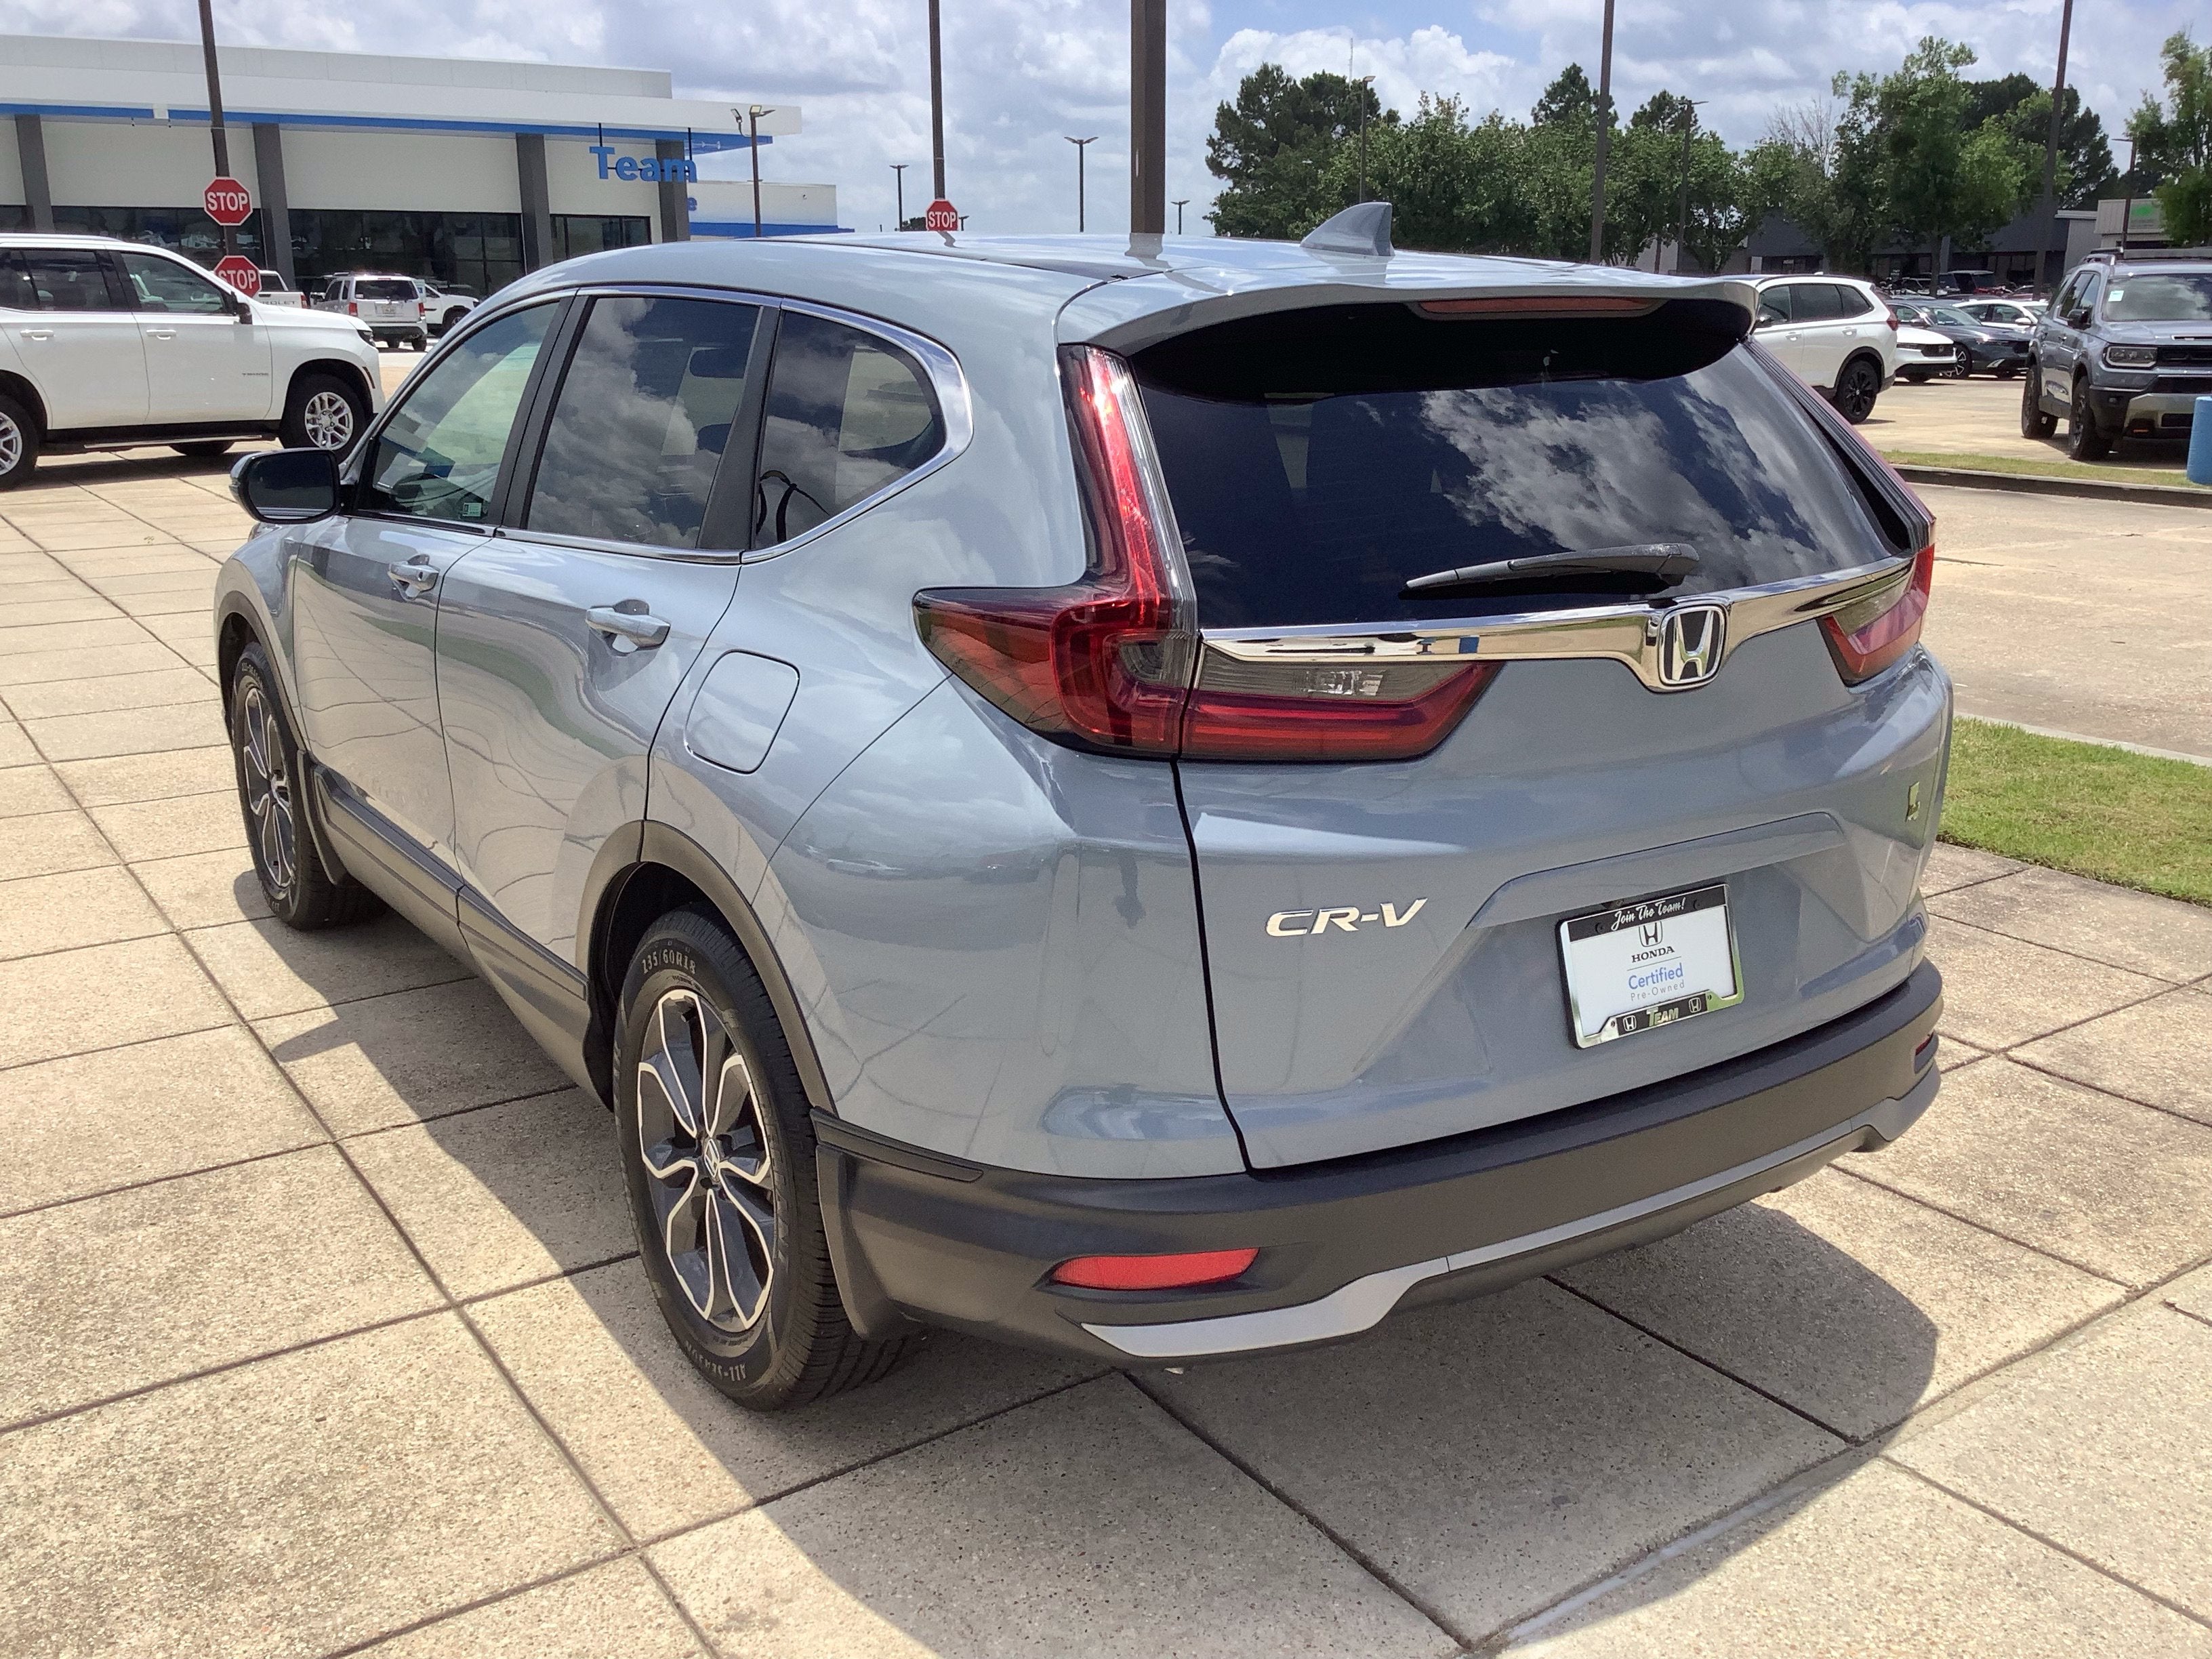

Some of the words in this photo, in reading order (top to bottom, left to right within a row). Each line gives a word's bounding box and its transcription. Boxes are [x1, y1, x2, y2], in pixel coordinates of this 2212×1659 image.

[589, 146, 697, 183] Team
[207, 192, 248, 211] STOP
[928, 211, 957, 228] STOP
[1265, 897, 1428, 937] CR-V
[1611, 910, 1635, 931] Join
[1635, 905, 1655, 920] The
[1654, 897, 1686, 916] Team!
[1631, 946, 1675, 963] HONDA
[1629, 962, 1683, 989] Certified
[1631, 979, 1685, 1001] Pre-Owned
[1646, 1006, 1679, 1027] TEAM
